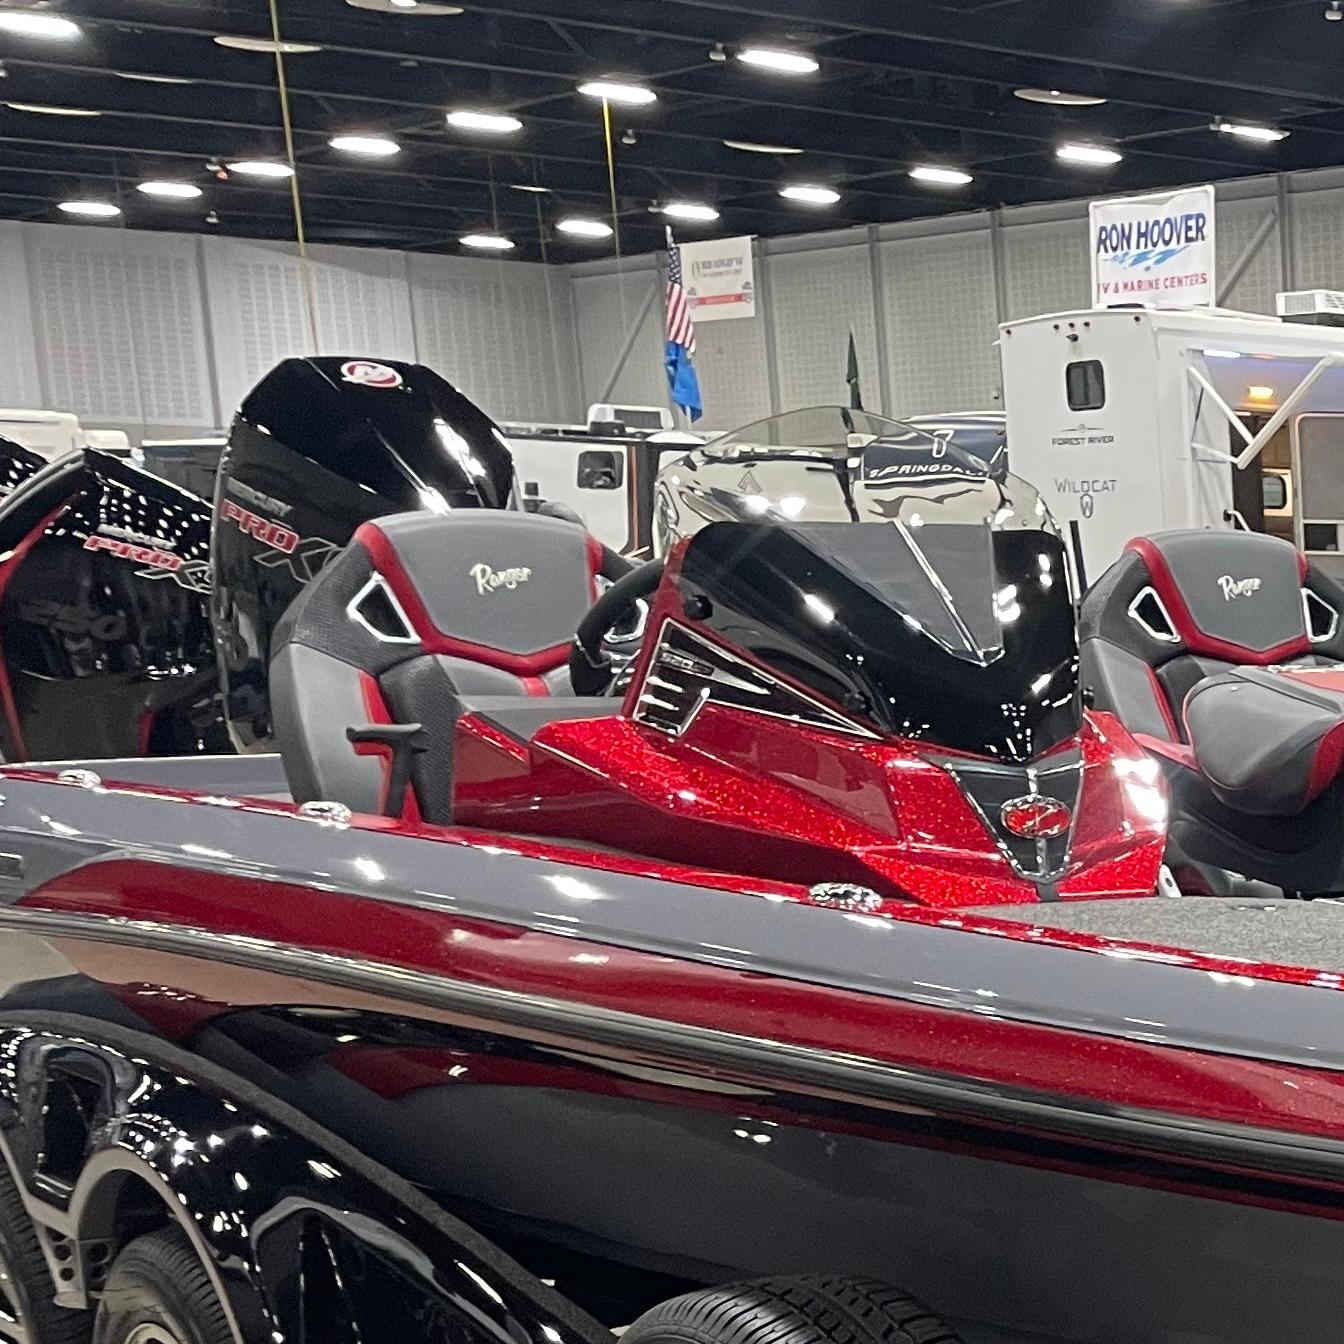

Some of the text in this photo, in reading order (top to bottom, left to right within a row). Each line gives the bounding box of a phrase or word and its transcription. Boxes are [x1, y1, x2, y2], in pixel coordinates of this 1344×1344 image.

[1097, 212, 1206, 254] RON HOOVER
[1123, 278, 1160, 293] MARINE
[1163, 273, 1208, 289] CENTERS
[1054, 478, 1117, 493] WILDCAT
[469, 563, 533, 597] Ranger
